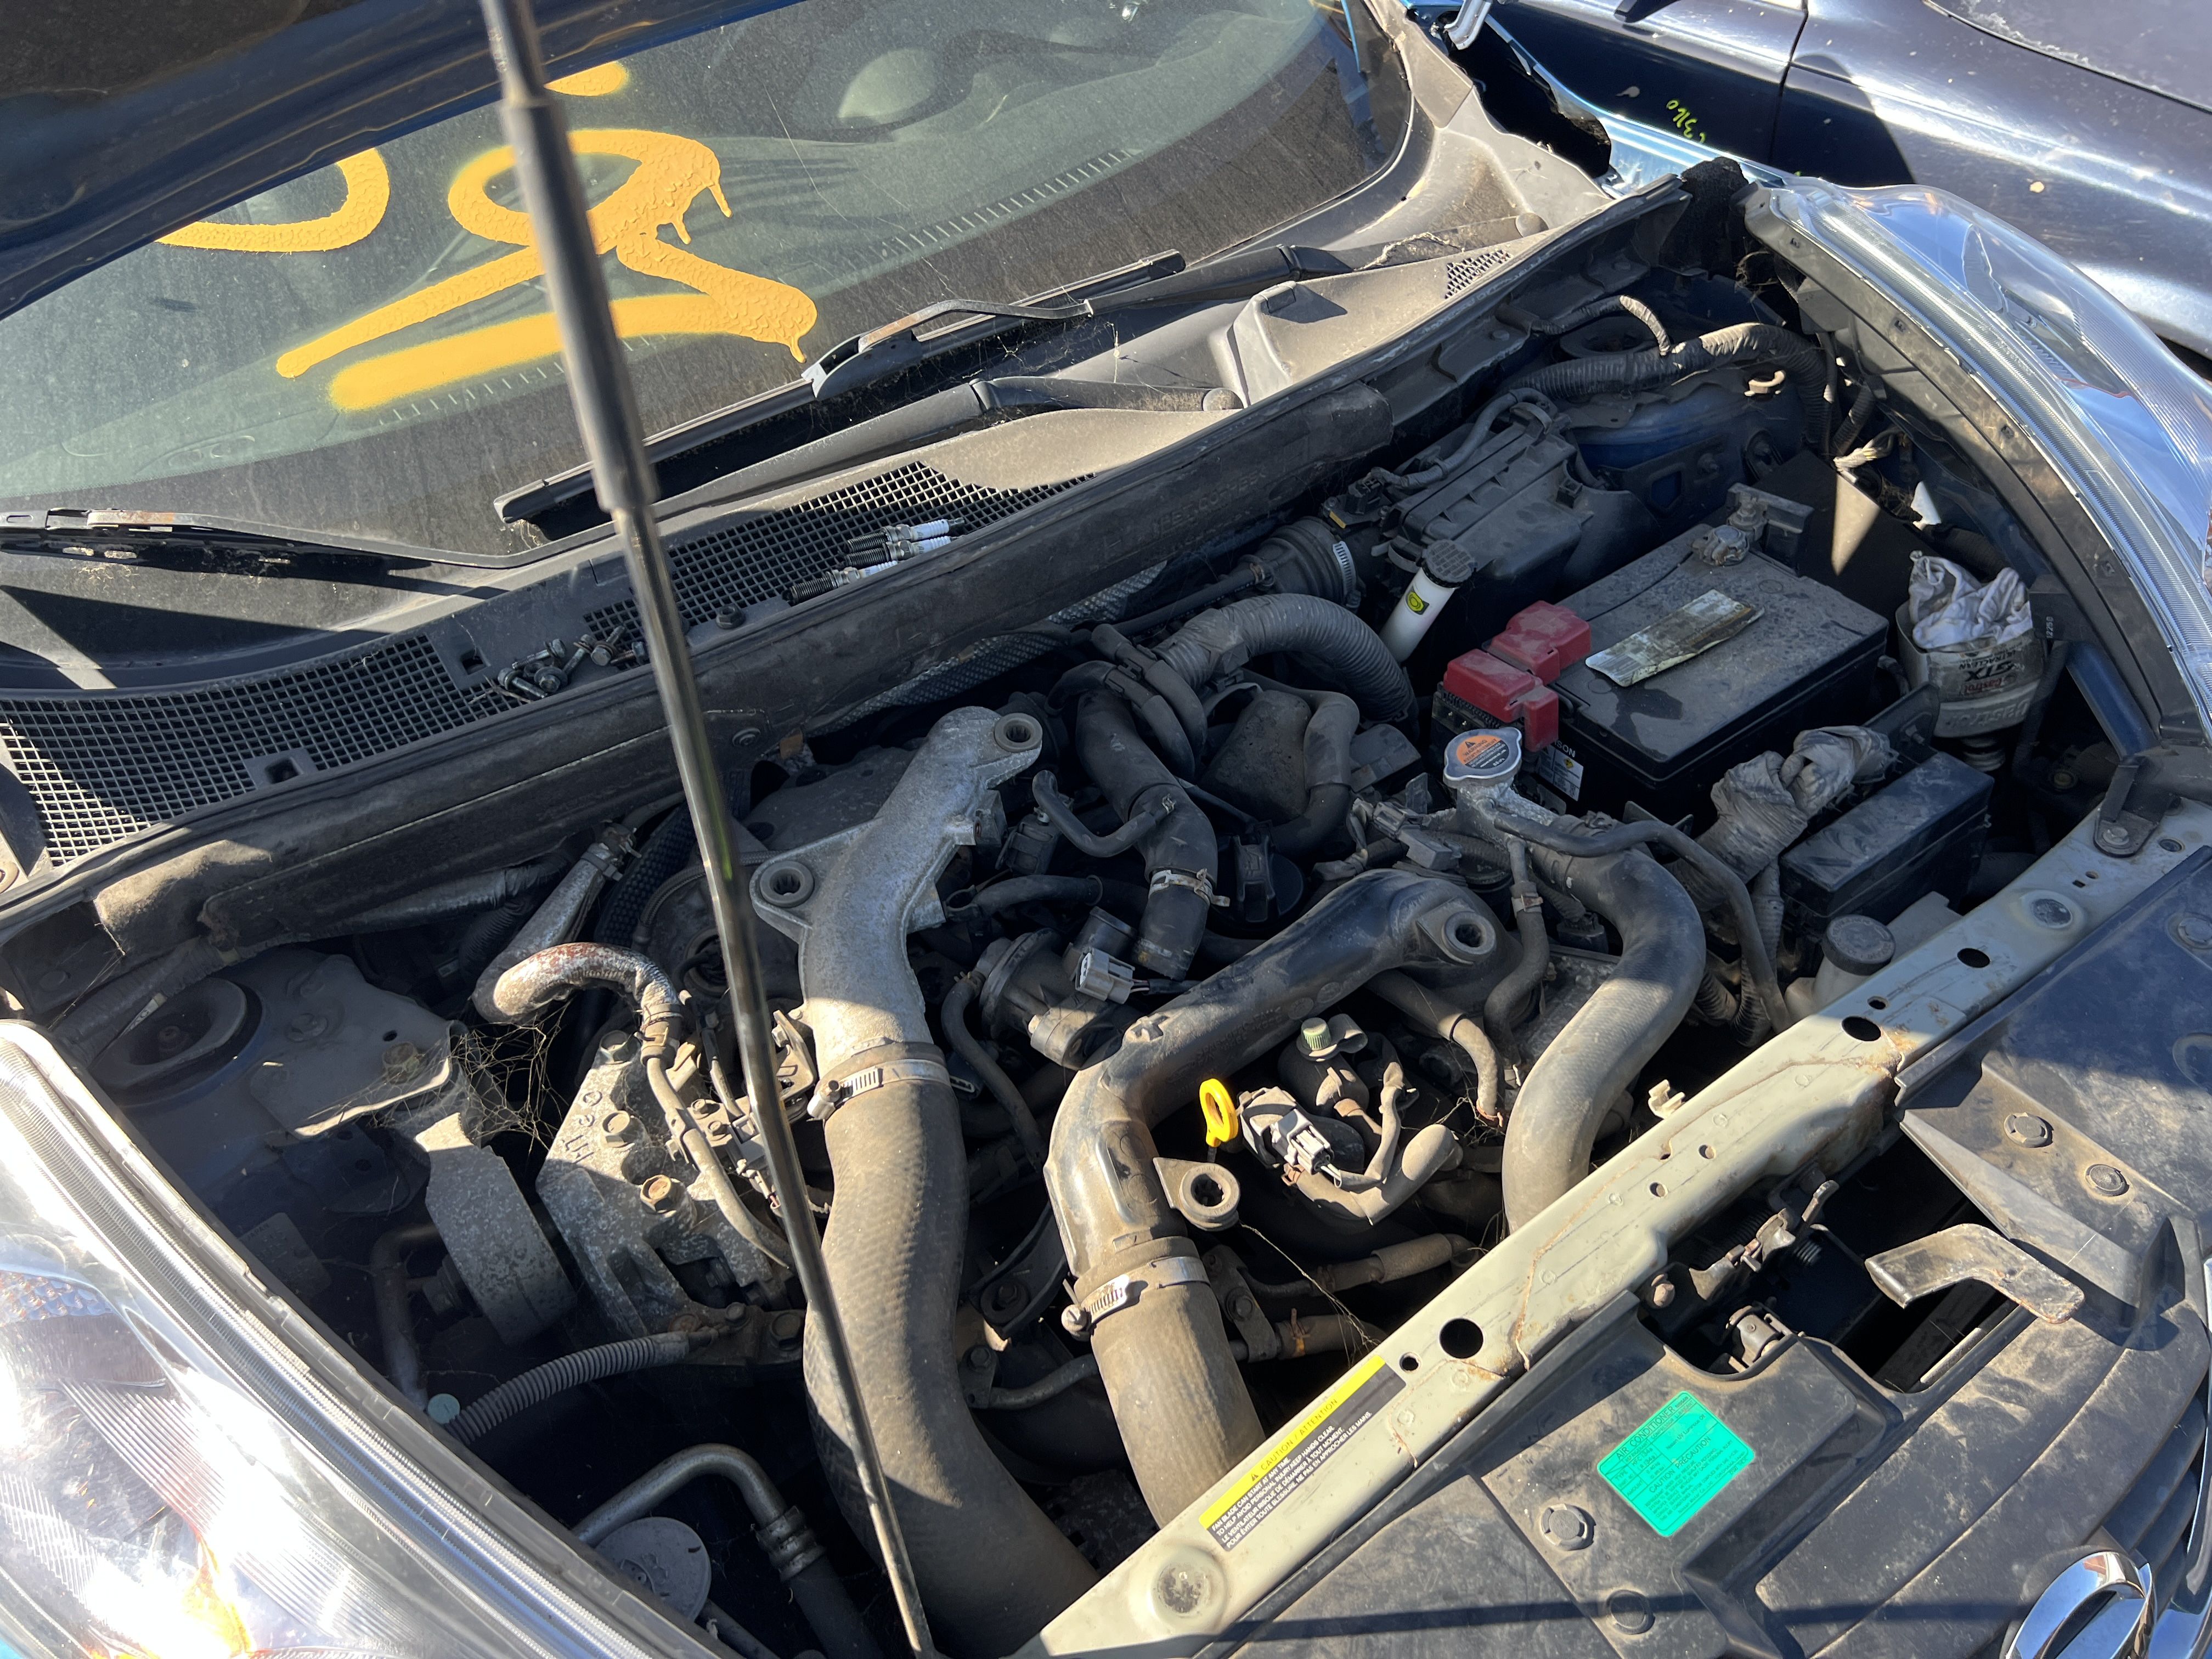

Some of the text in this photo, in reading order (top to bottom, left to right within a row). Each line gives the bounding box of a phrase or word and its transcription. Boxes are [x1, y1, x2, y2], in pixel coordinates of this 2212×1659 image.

[1965, 661, 2017, 682] GTX
[1260, 1439, 1294, 1471] CAUTION
[1298, 1398, 1338, 1435] ATTENTION
[1615, 1404, 1675, 1460] AIR CONDITIONER
[1648, 1468, 1676, 1493] CAUTION
[1674, 1434, 1712, 1469] PRÉCAUTION
[1211, 1520, 1223, 1532] FAN
[1221, 1505, 1239, 1522] BLADE
[1236, 1496, 1249, 1508] CAN
[1246, 1482, 1263, 1498] START
[1261, 1476, 1269, 1485] AT
[1267, 1467, 1279, 1479] ANY
[1216, 1527, 1225, 1536] TO
[1223, 1515, 1238, 1530] HELP
[1235, 1502, 1252, 1518] AVOID
[1249, 1480, 1276, 1505] PERSONAL
[1301, 1439, 1319, 1457] HANDS
[1221, 1534, 1229, 1543] LE
[1227, 1506, 1259, 1537] VENTILATEUR
[1257, 1490, 1277, 1509] RISQUE
[1274, 1483, 1283, 1493] DE
[1280, 1459, 1308, 1486] DÉMARRER
[1310, 1445, 1324, 1460] TOUT
[1226, 1532, 1243, 1548] POUR
[1239, 1516, 1257, 1534] ÉVITER
[1255, 1503, 1273, 1521] TOUTE
[1295, 1473, 1305, 1483] NE
[1302, 1464, 1314, 1476] PAS
[1311, 1458, 1321, 1468] EN
[1319, 1432, 1348, 1460] APPROCHER
[1346, 1424, 1357, 1435] LES
